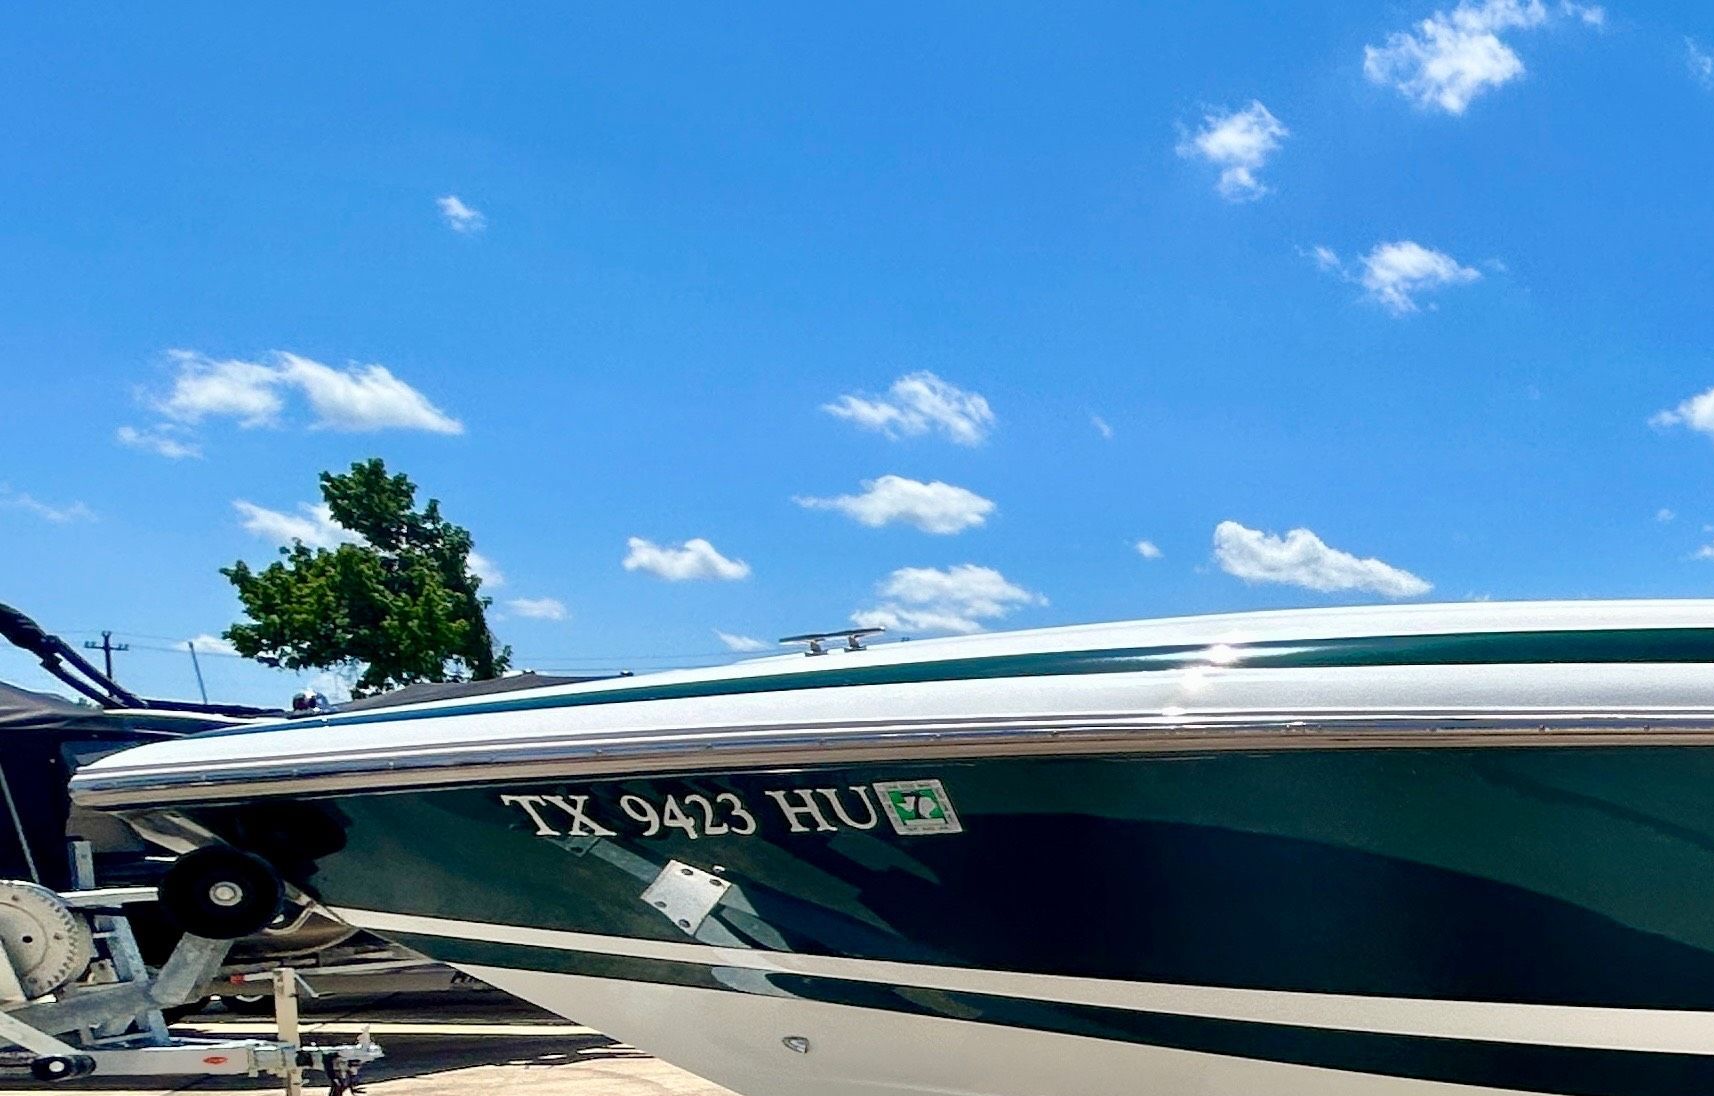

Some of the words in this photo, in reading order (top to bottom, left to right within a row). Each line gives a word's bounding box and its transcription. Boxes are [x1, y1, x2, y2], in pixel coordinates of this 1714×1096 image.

[501, 794, 617, 837] TX
[620, 793, 757, 839] 9423
[766, 786, 879, 834] HU
